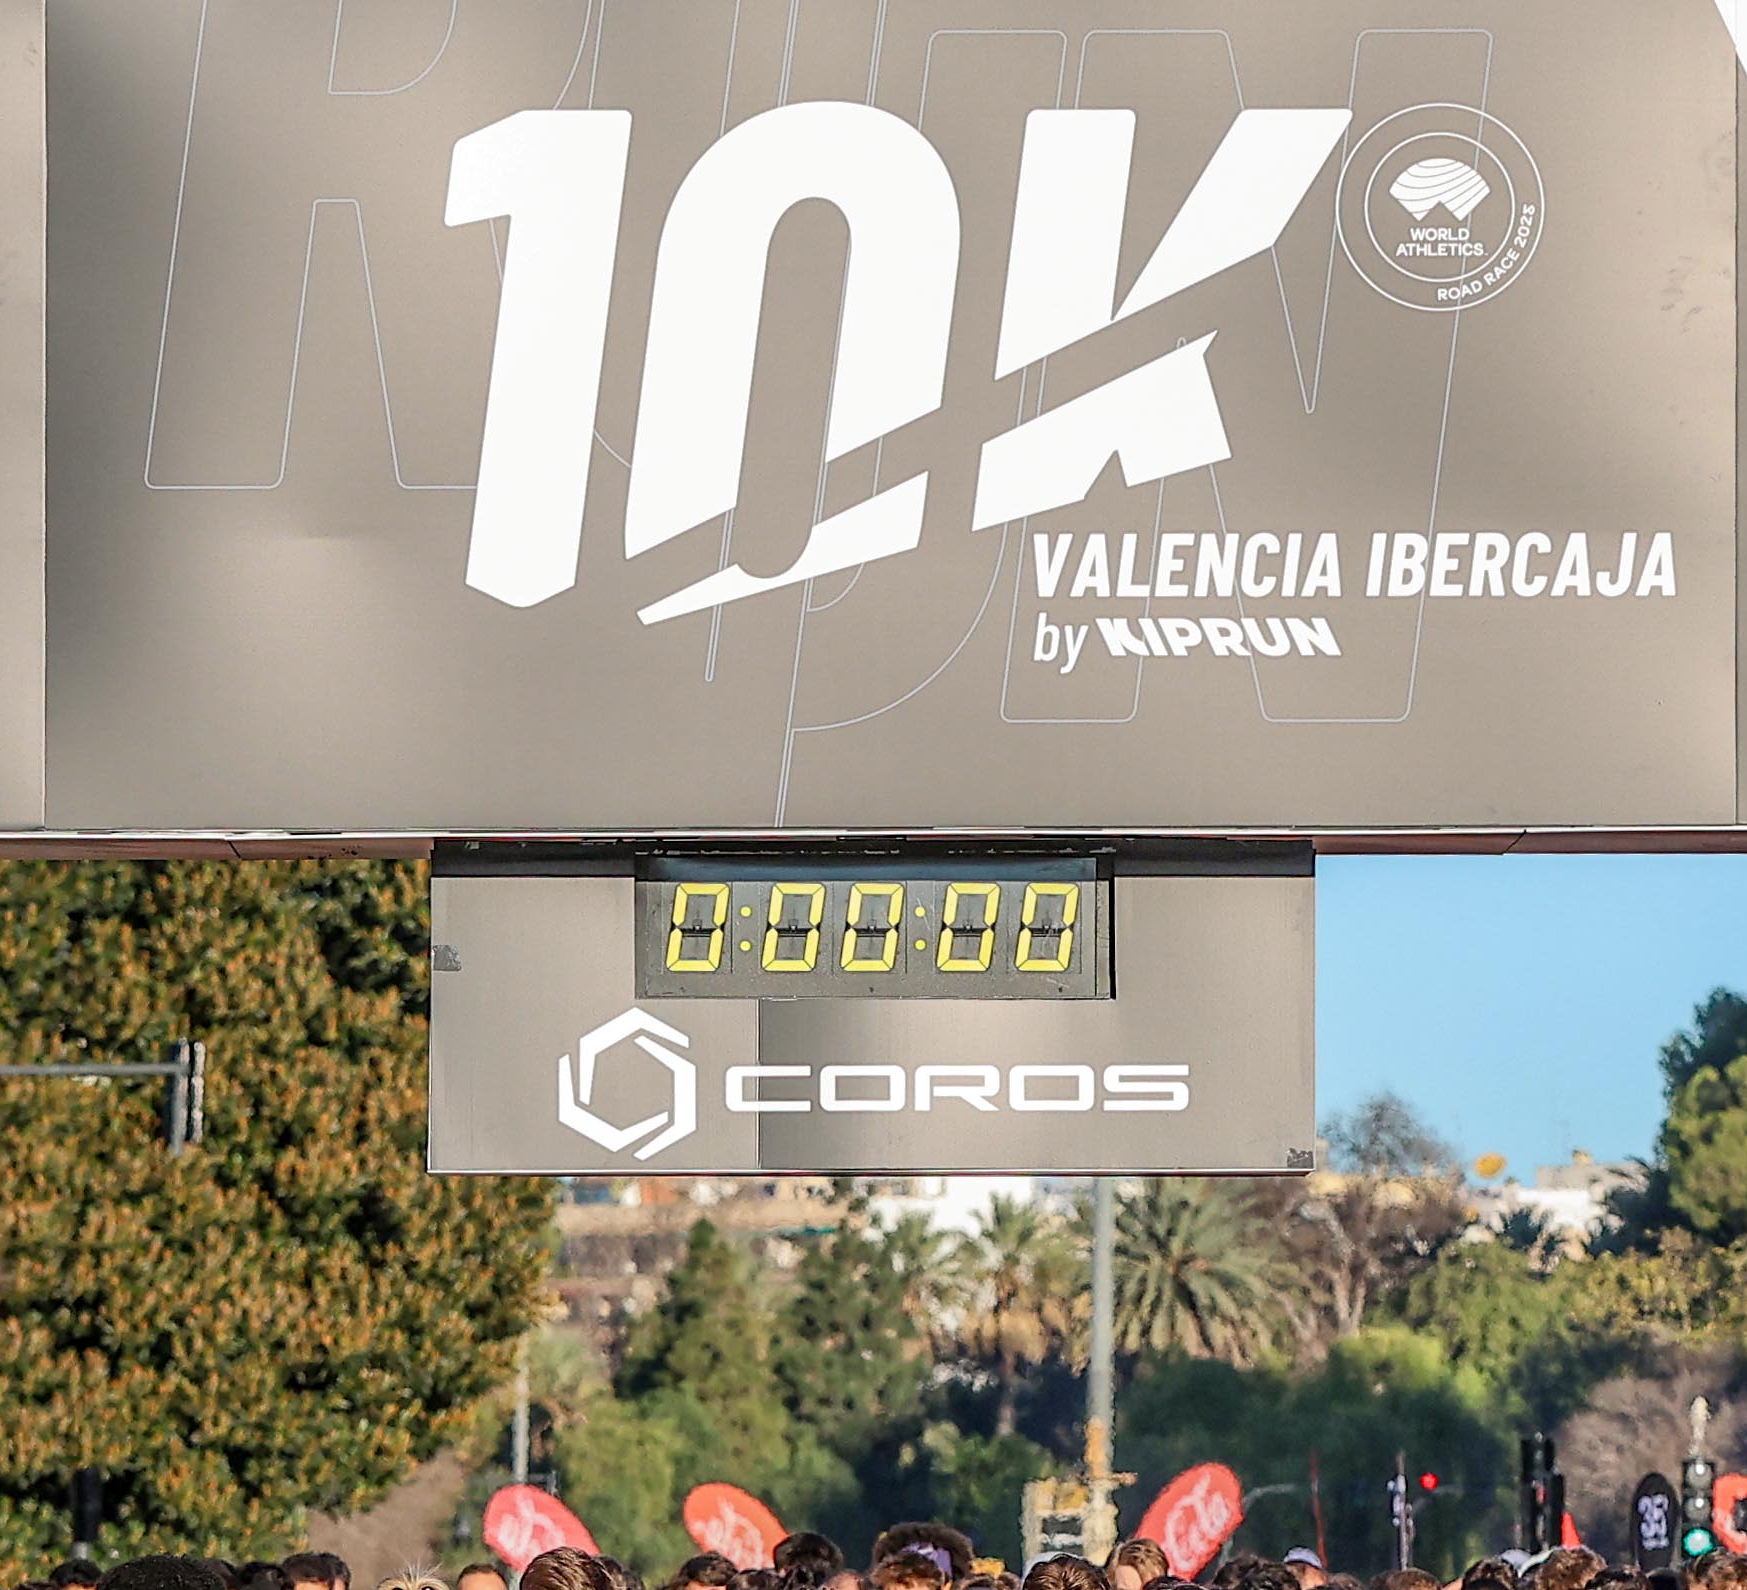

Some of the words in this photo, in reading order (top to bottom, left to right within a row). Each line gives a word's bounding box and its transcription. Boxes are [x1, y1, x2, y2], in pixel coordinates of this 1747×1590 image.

[1395, 242, 1485, 257] ATHLETICS
[1410, 227, 1470, 241] WORLD
[1437, 279, 1483, 302] ROAD
[1483, 251, 1521, 286] RACE
[1514, 203, 1536, 247] 2025
[442, 101, 1353, 626] 10K
[1032, 529, 1343, 601] VALENCIA
[1363, 529, 1679, 601] IBERCAJA
[1032, 612, 1089, 675] by
[1095, 616, 1342, 658] KIPRUN
[665, 881, 1081, 973] 0:00:00
[725, 1065, 1190, 1114] COROS
